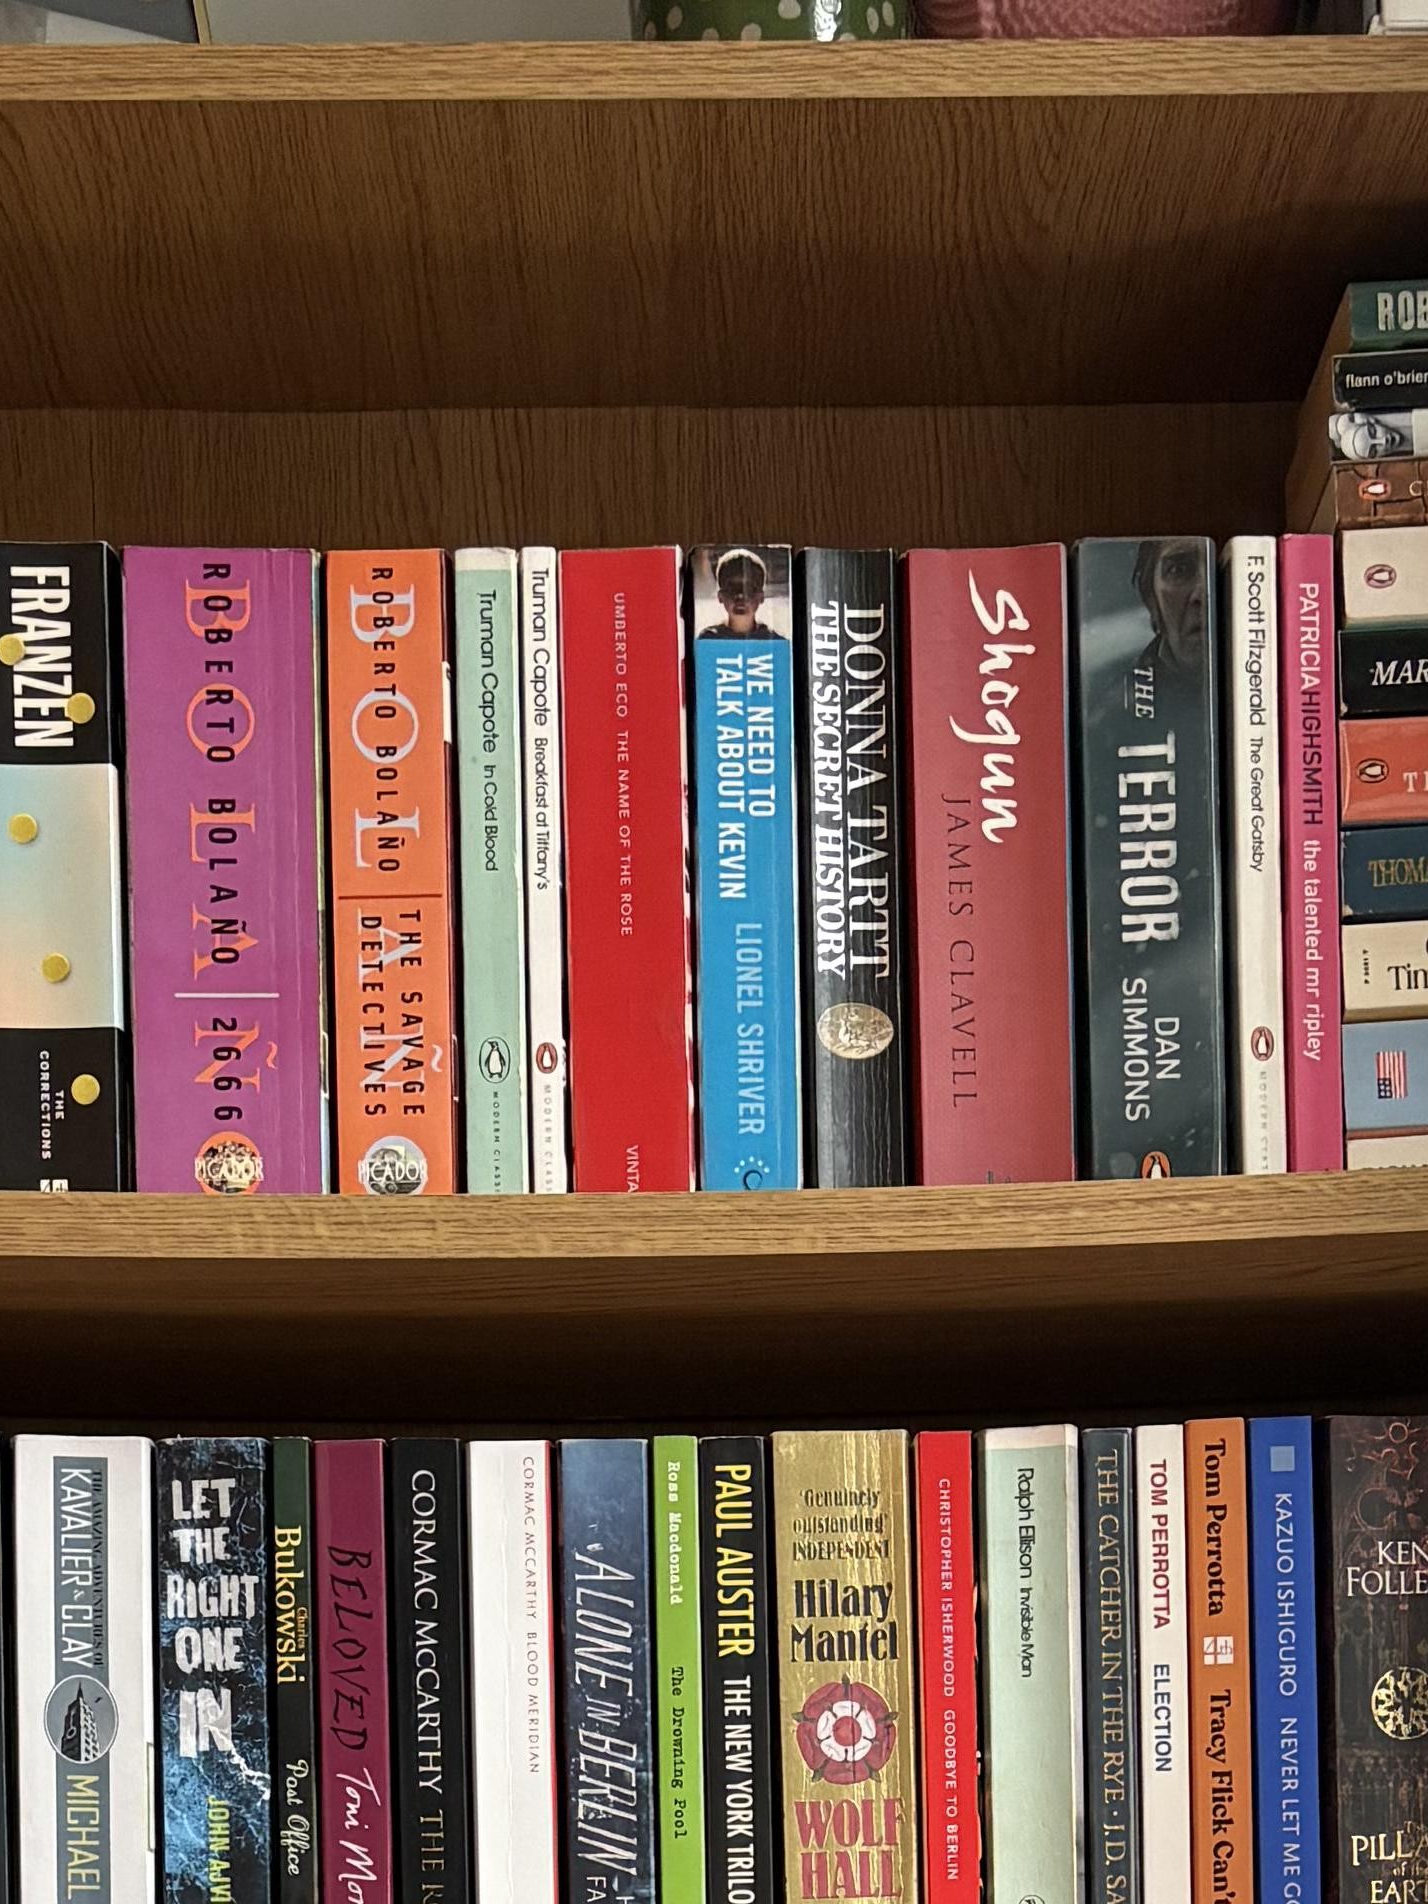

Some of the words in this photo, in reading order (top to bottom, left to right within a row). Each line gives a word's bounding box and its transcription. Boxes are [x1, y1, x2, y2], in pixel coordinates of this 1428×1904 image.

[478, 590, 496, 668] Truman
[479, 673, 498, 753] Capote
[950, 568, 1035, 844] Shogun
[483, 765, 496, 778] In
[484, 782, 496, 822] Cold
[485, 825, 498, 872] Blood
[940, 793, 973, 918] JAMES
[1117, 734, 1180, 944] TERROR
[947, 938, 978, 1108] CLAVELL
[1122, 978, 1150, 1121] SIMMONS
[1153, 1016, 1180, 1080] DAN
[173, 1478, 235, 1520] LET
[715, 1464, 751, 1537] PAUL
[1150, 1460, 1167, 1505] TOM
[174, 1526, 230, 1563] THE
[411, 1469, 438, 1608] CORMAC
[1274, 1494, 1294, 1572] KAZUO
[166, 1575, 258, 1620] RIGHT
[275, 1525, 305, 1684] Bukowski
[718, 1547, 755, 1658] AUSTER
[794, 1580, 893, 1619] Hilary
[1151, 1514, 1170, 1630] PERROTTA
[175, 1627, 242, 1673] ONE
[791, 1624, 898, 1663] Mantel
[1276, 1579, 1297, 1697] ISHIGURO
[180, 1688, 231, 1761] IN
[414, 1619, 442, 1794] MCCARTHY
[723, 1676, 749, 1717] THE
[1153, 1663, 1171, 1773] ELECTION
[725, 1723, 751, 1773] NEW
[1280, 1718, 1299, 1791] NEVER
[419, 1809, 443, 1874] THE
[727, 1778, 752, 1837] YORK
[1282, 1798, 1300, 1836] LET
[1283, 1841, 1300, 1876] ME
